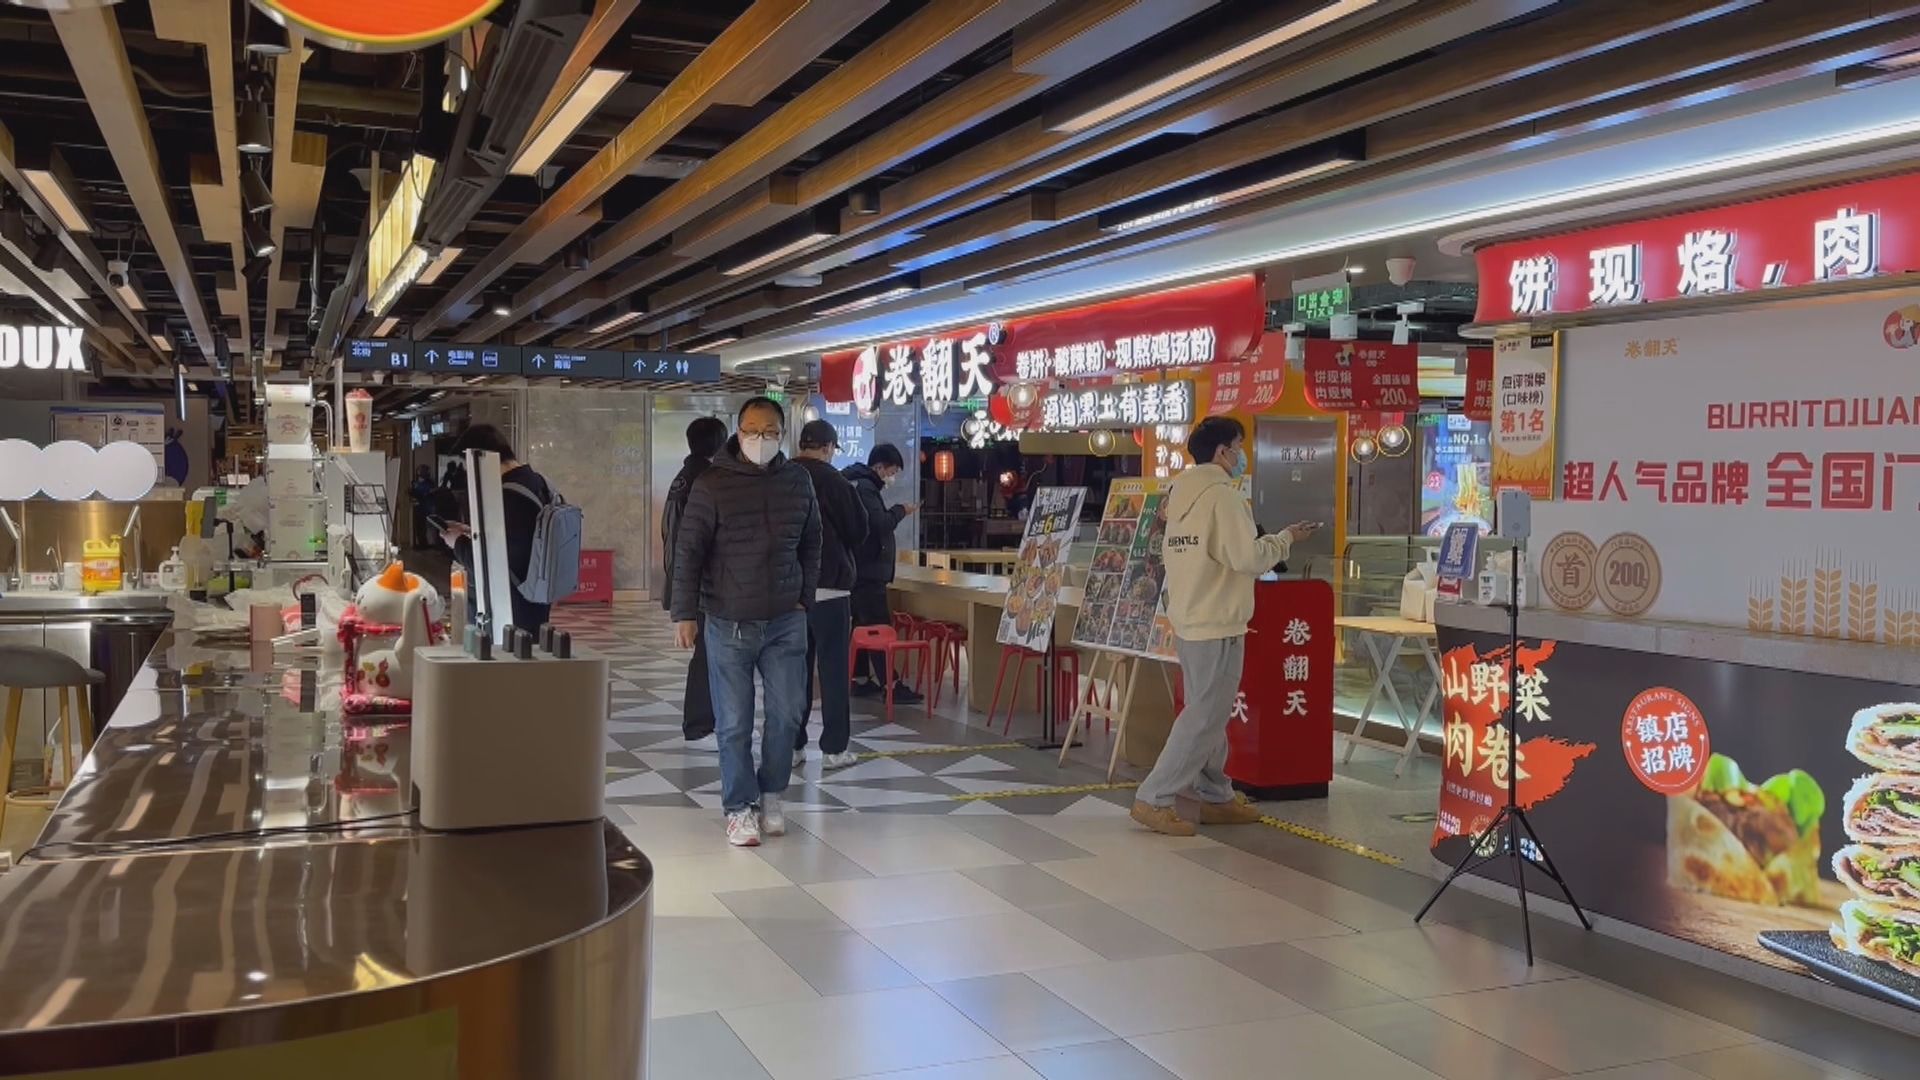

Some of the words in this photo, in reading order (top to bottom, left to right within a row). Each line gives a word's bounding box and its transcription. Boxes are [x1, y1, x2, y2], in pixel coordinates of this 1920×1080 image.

[391, 352, 408, 367] B1
[1624, 338, 1678, 358] 卷翻天
[880, 332, 993, 405] 卷翻天
[1502, 372, 1545, 389] 点评榜单
[1502, 390, 1544, 407] (口味榜)
[1500, 408, 1545, 432] 第1名
[1563, 460, 1749, 505] 超人气品牌
[1555, 552, 1586, 588] 首
[1282, 618, 1311, 715] 卷翻天
[1441, 656, 1552, 722] 山野菜
[1635, 712, 1689, 743] 镇店
[1446, 711, 1531, 790] 肉卷
[1640, 742, 1696, 774] 招牌
